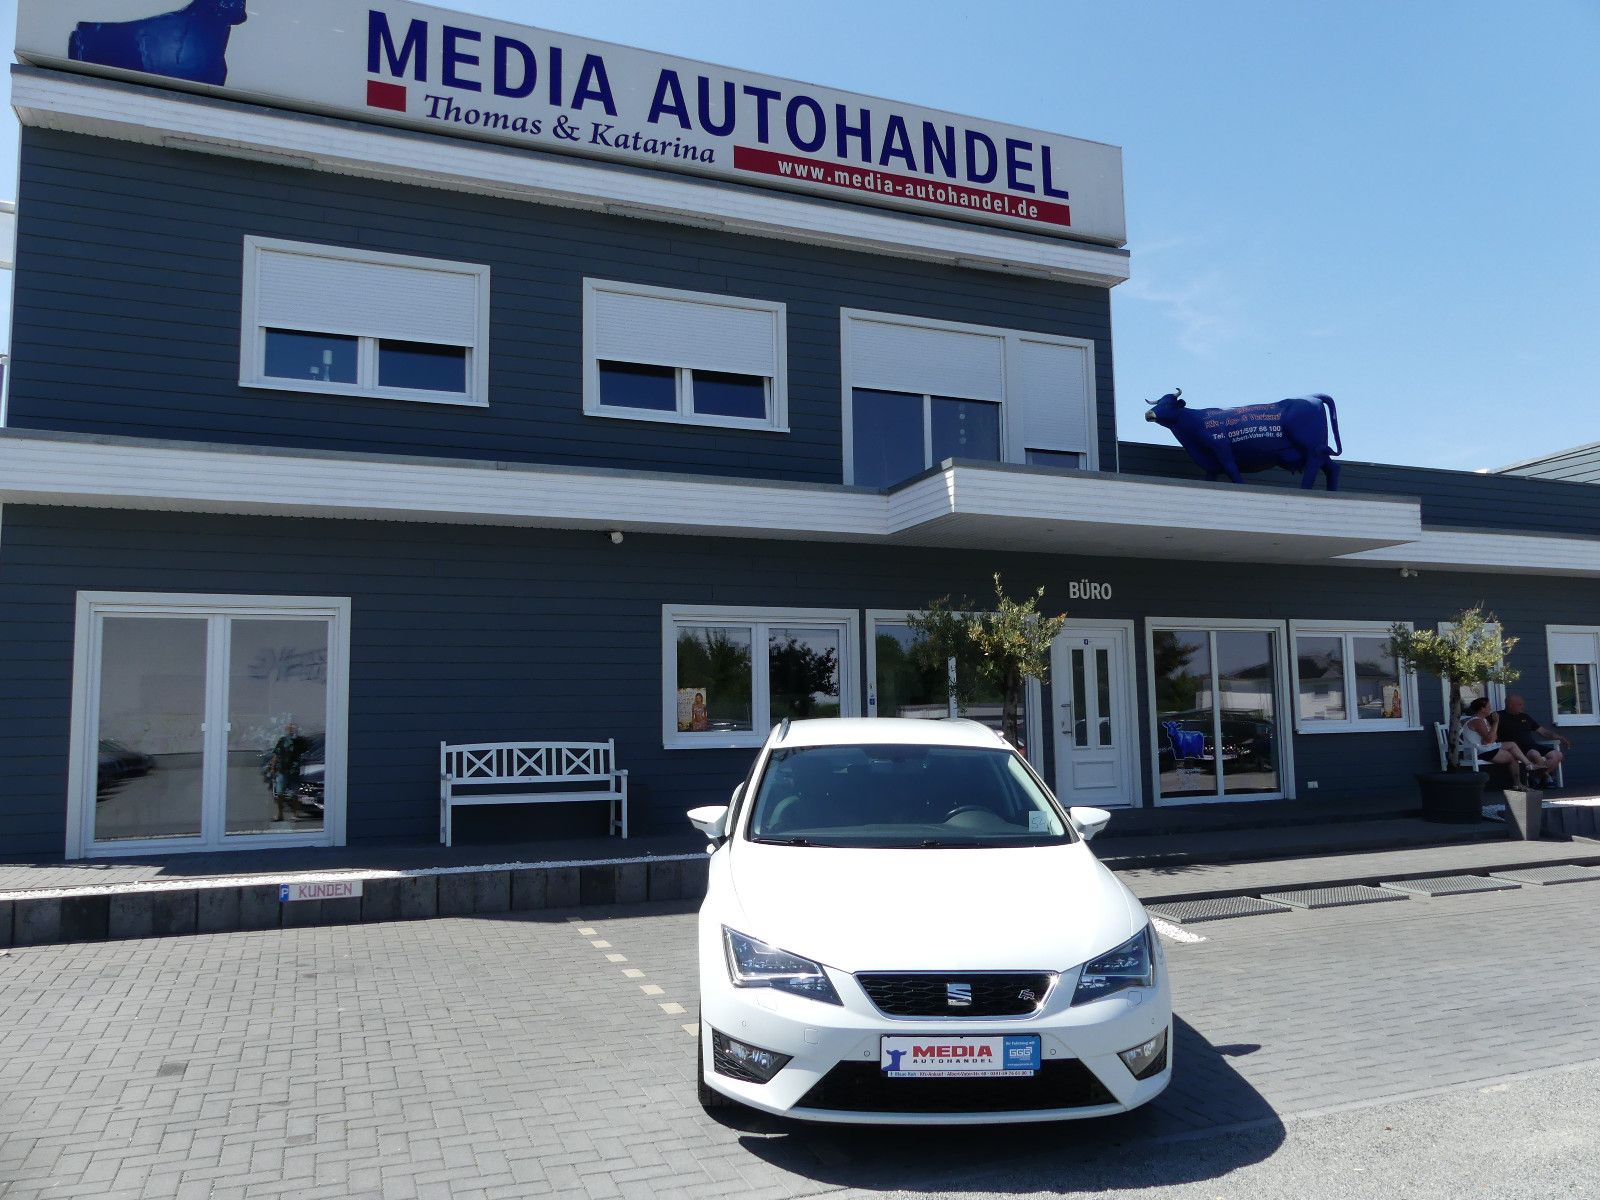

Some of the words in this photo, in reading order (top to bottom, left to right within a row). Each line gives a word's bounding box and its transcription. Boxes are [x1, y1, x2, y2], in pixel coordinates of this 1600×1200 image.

[367, 10, 618, 117] MEDIA
[647, 68, 1069, 200] AUTOHANDEL
[424, 94, 542, 135] Thomas
[552, 115, 580, 141] &
[588, 121, 715, 164] Katarina
[778, 159, 1038, 219] www.media-autohandel.de
[1212, 432, 1226, 440] Tel.
[1069, 579, 1112, 600] BÜRO
[299, 882, 352, 899] KUNDEN
[912, 1046, 992, 1057] MEDIA
